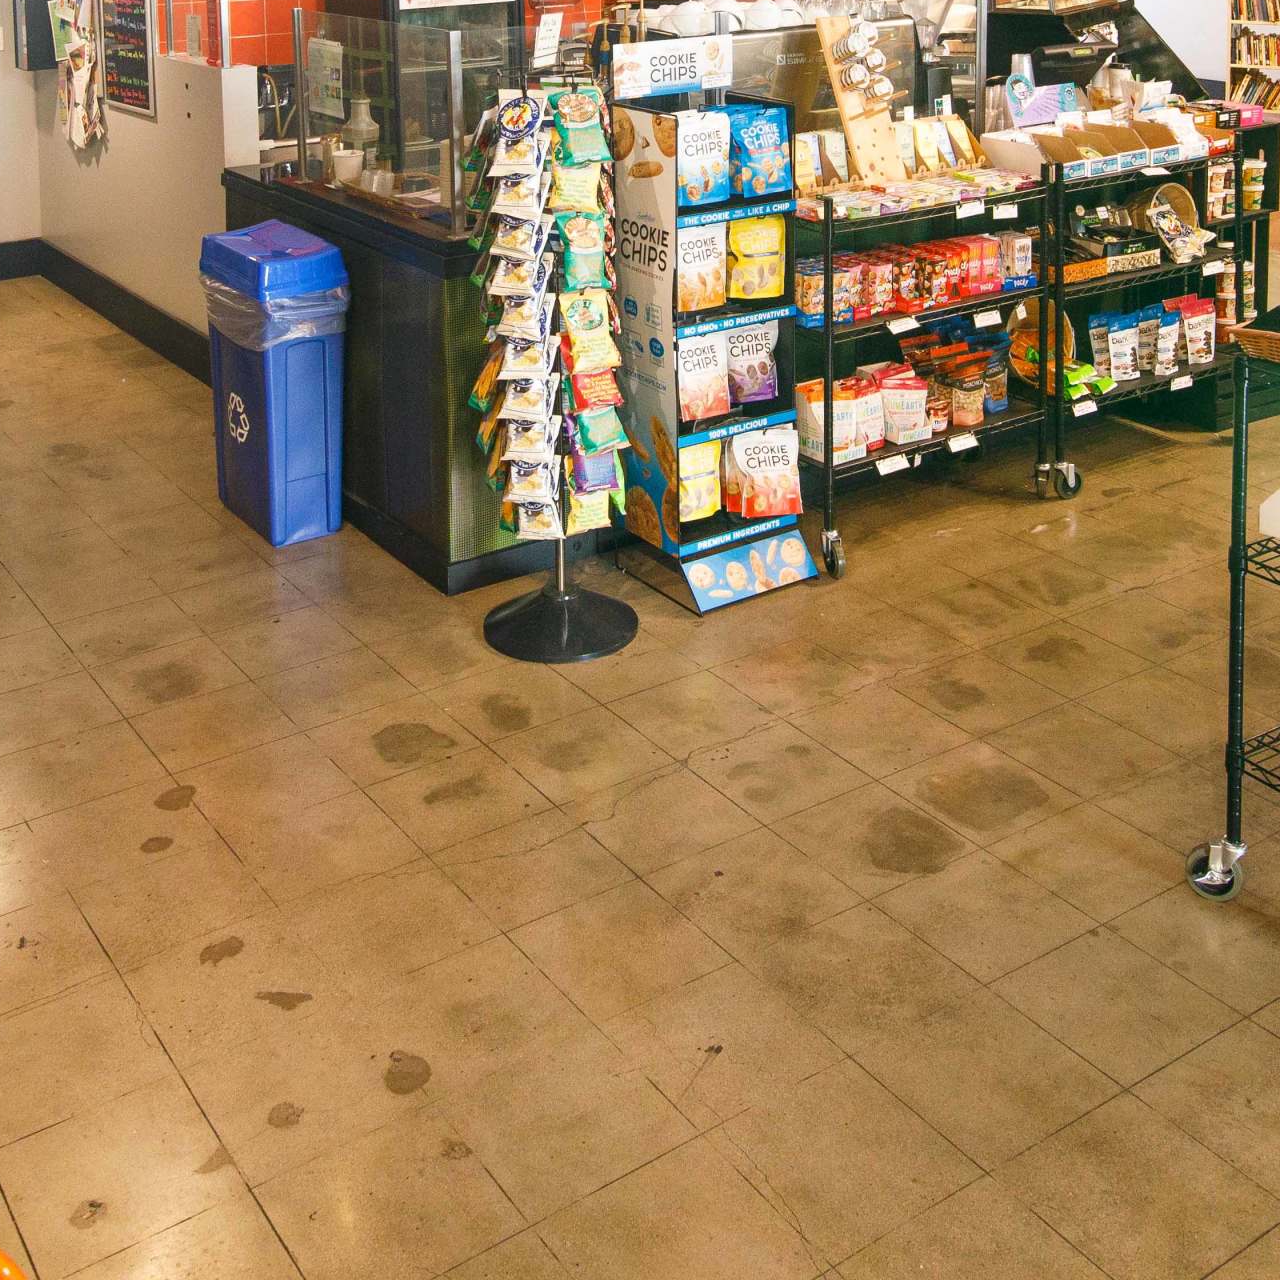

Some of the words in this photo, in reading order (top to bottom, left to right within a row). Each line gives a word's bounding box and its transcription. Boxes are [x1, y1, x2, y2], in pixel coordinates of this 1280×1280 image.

[650, 53, 697, 67] COOKIE
[650, 65, 697, 83] CHIPS
[684, 130, 722, 144] COOKIE
[741, 123, 779, 137] COOKIE
[685, 140, 723, 158] CHIPS
[744, 132, 781, 154] CHIPS
[701, 212, 731, 223] COOKIE
[748, 206, 764, 216] LIKE
[766, 205, 774, 214] A
[773, 203, 791, 213] CHIP
[621, 218, 670, 248] COOKIE
[680, 236, 717, 252] COOKIE
[620, 238, 668, 272] CHIPS
[682, 247, 720, 264] CHIPS
[684, 326, 696, 335] NO
[697, 323, 718, 334] GMOs
[723, 319, 734, 328] NO
[735, 308, 790, 325] PRESERVATIVES
[729, 332, 771, 345] COOKIE
[680, 344, 716, 360] COOKIE
[730, 342, 771, 358] CHIPS
[683, 355, 718, 372] CHIPS
[709, 428, 728, 439] 100%
[729, 418, 768, 434] DELICIOUS
[745, 444, 789, 457] COOKIE
[746, 455, 791, 470] CHIPS
[697, 532, 731, 551] PREMIUM
[732, 519, 780, 539] INGREDIENTS
